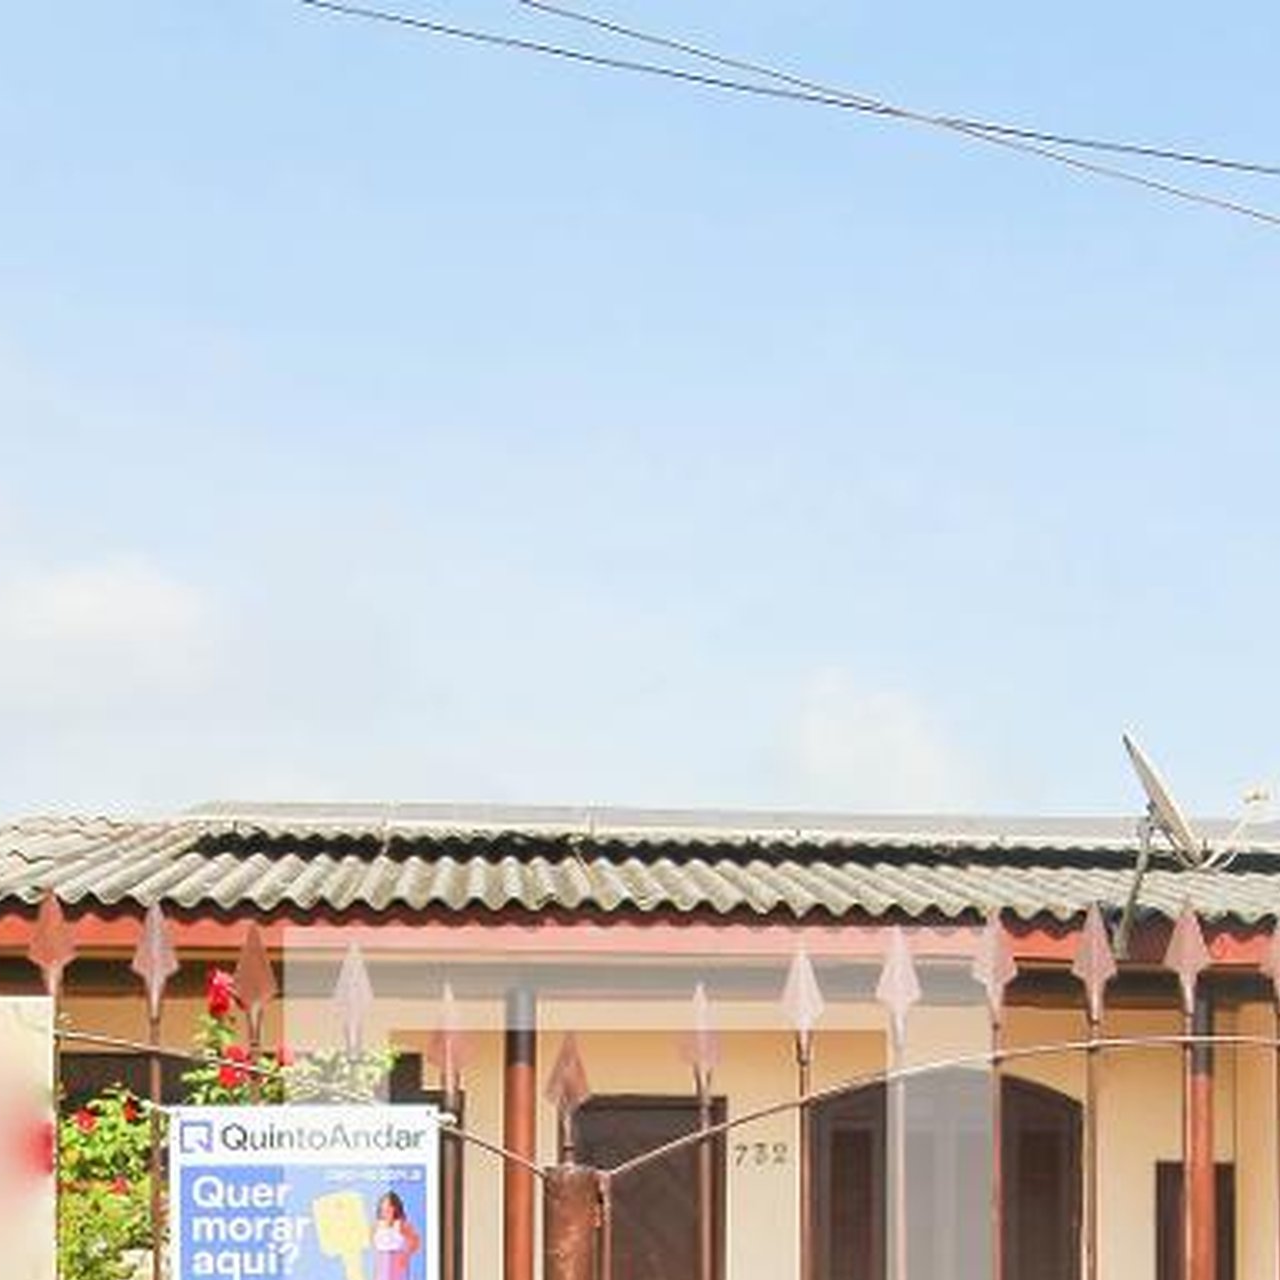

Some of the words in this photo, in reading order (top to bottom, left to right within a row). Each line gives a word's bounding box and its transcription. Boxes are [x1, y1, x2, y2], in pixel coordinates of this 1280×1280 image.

[219, 1122, 426, 1151] QuintoAndar
[192, 1175, 293, 1208] Quer
[192, 1215, 310, 1242] morar
